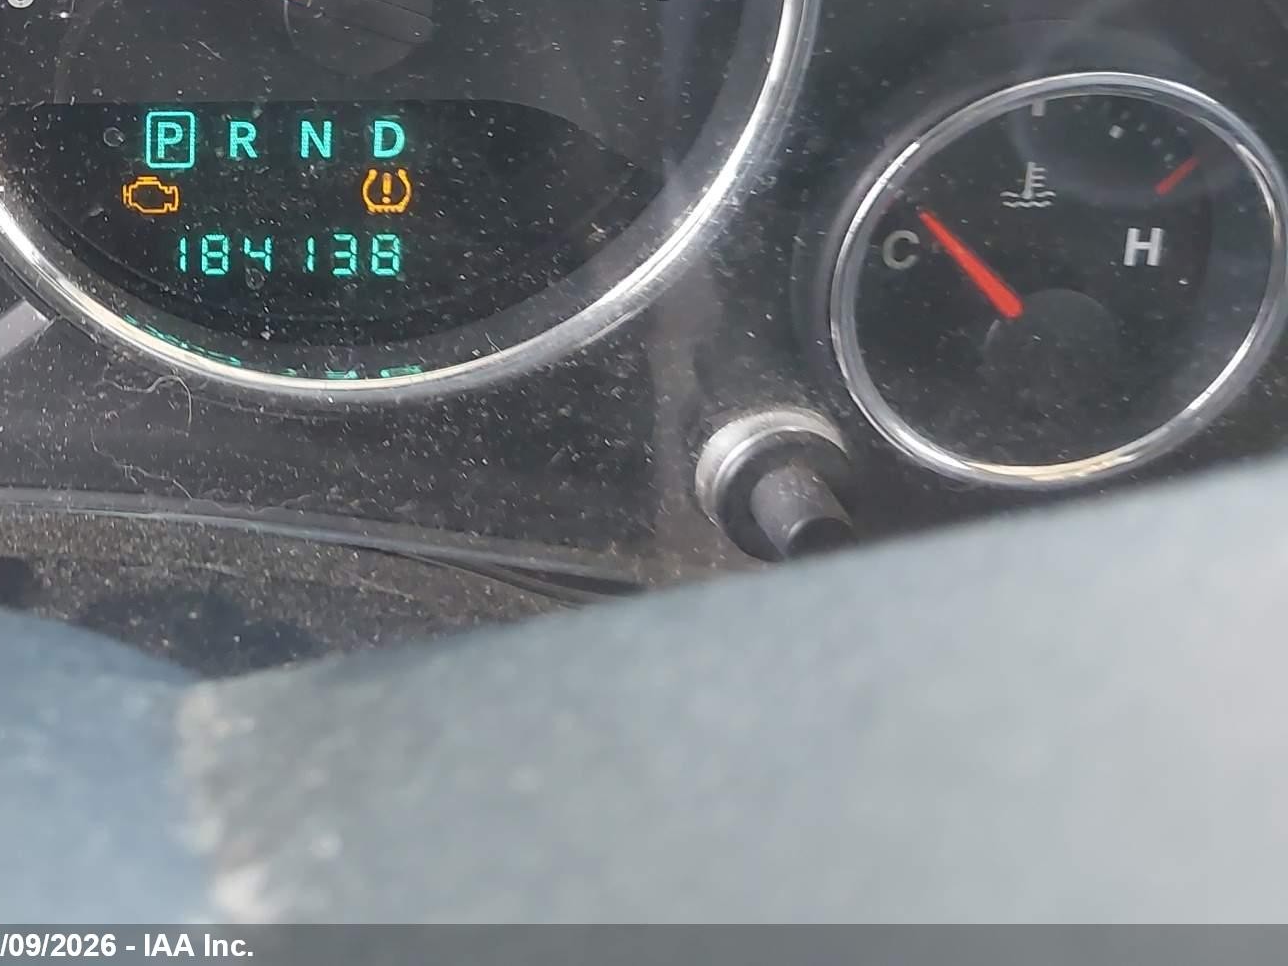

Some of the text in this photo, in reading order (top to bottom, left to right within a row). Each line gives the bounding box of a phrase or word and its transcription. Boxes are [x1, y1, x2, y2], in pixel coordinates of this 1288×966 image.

[157, 121, 405, 158] P R N D
[178, 233, 401, 275] 184138
[882, 230, 920, 270] C
[1123, 227, 1164, 267] H
